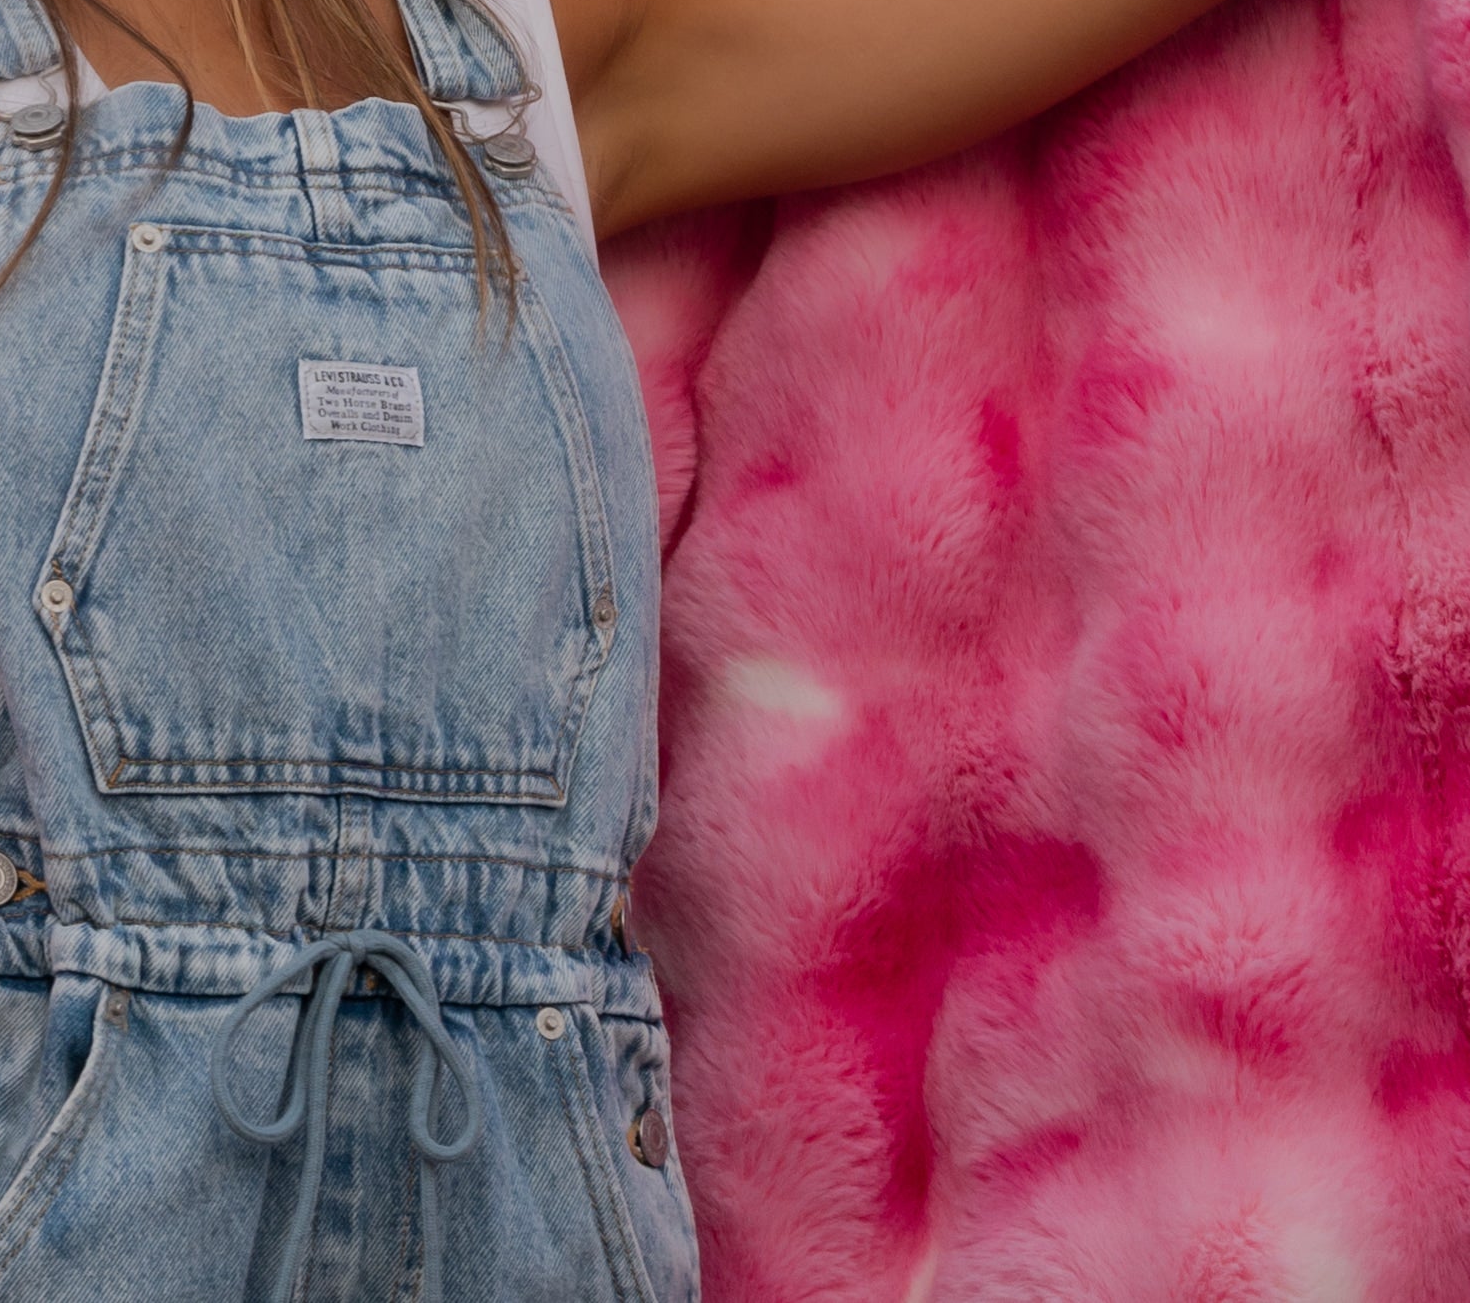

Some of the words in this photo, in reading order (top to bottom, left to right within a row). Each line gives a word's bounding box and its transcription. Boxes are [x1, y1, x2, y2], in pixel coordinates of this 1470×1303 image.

[314, 371, 336, 383] LEVI
[337, 372, 381, 385] STRAUSS
[317, 396, 339, 407] Two
[343, 398, 377, 409] Horse
[381, 400, 412, 411] Brand
[318, 408, 359, 419] Overalls
[362, 411, 380, 421] and
[383, 411, 413, 424] Denim
[331, 420, 358, 431] Work
[361, 422, 401, 435] Clothing
